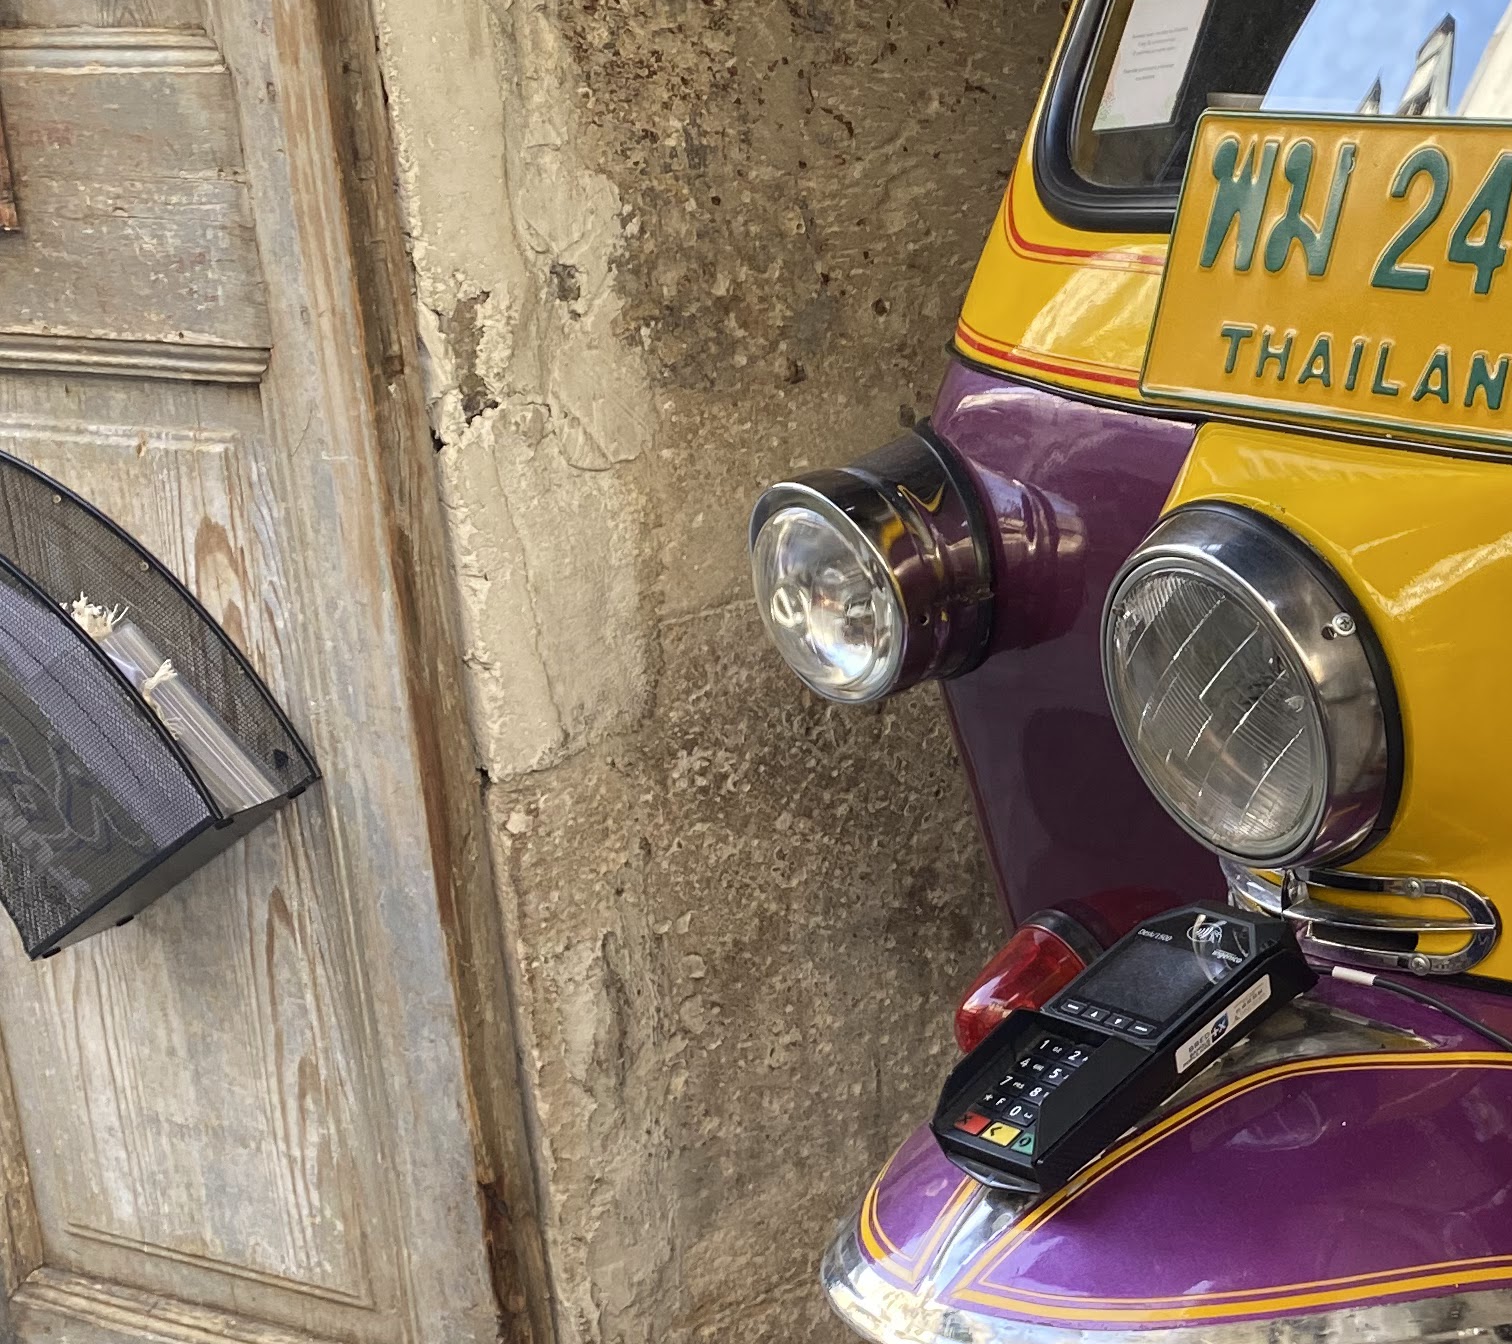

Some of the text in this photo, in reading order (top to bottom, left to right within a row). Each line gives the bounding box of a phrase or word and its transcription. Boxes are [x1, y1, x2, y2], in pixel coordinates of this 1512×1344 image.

[1020, 1058, 1062, 1079] 4 5
[1000, 1076, 1042, 1097] 7 8
